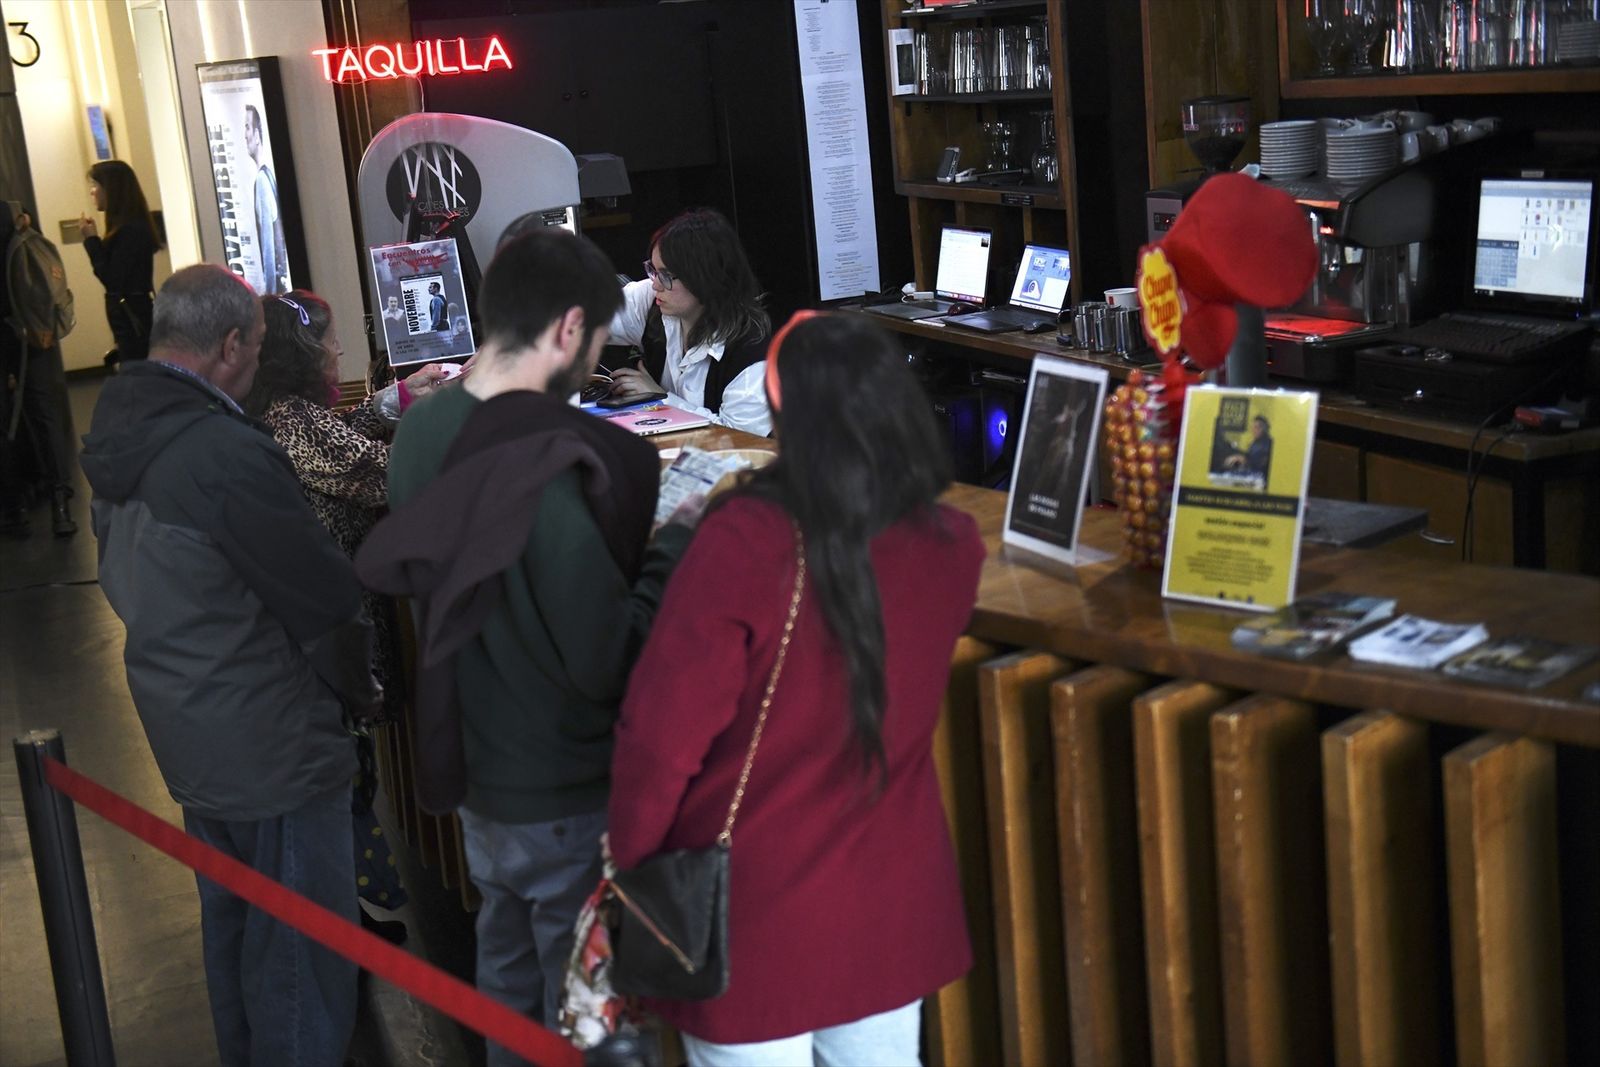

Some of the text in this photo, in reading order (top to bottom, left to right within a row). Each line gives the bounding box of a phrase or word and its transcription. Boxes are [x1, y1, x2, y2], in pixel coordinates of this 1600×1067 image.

[8, 22, 41, 68] 3
[311, 36, 513, 83] TAQUILLA
[208, 124, 245, 277] OVEMBRE
[382, 247, 432, 260] Encuentros
[403, 288, 421, 333] NOVEMBRE
